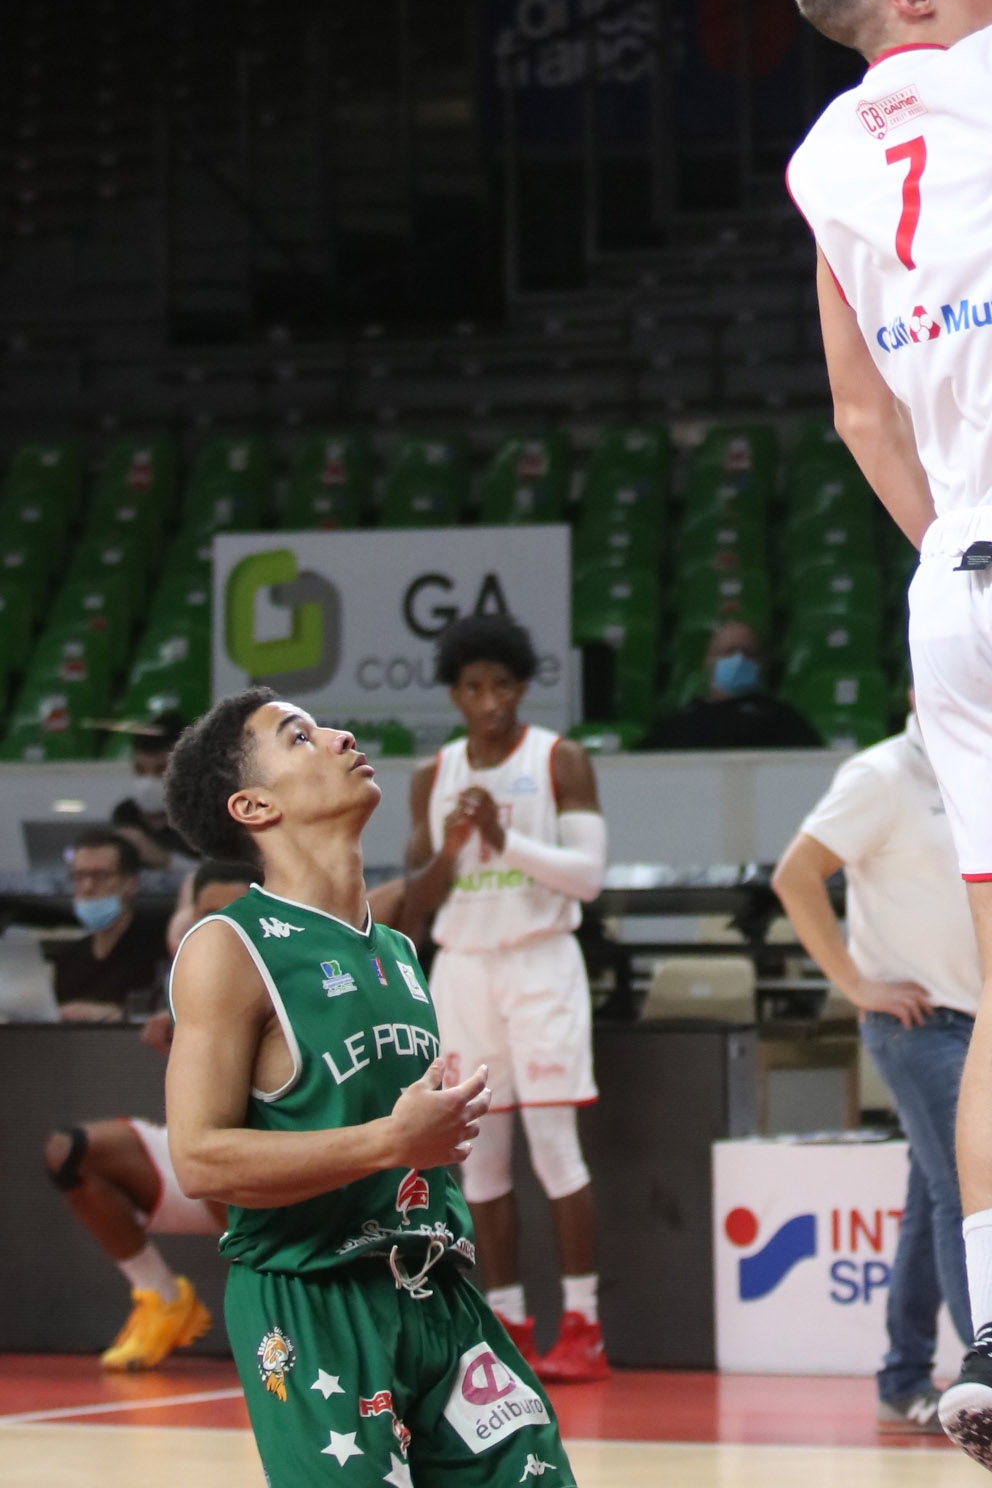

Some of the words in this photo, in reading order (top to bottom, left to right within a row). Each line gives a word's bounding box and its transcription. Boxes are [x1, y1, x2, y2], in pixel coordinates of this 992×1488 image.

[861, 107, 885, 132] CB
[885, 135, 927, 272] 7
[322, 1031, 370, 1085] LE
[829, 1259, 891, 1305] SP
[476, 1398, 544, 1440] édiburo
